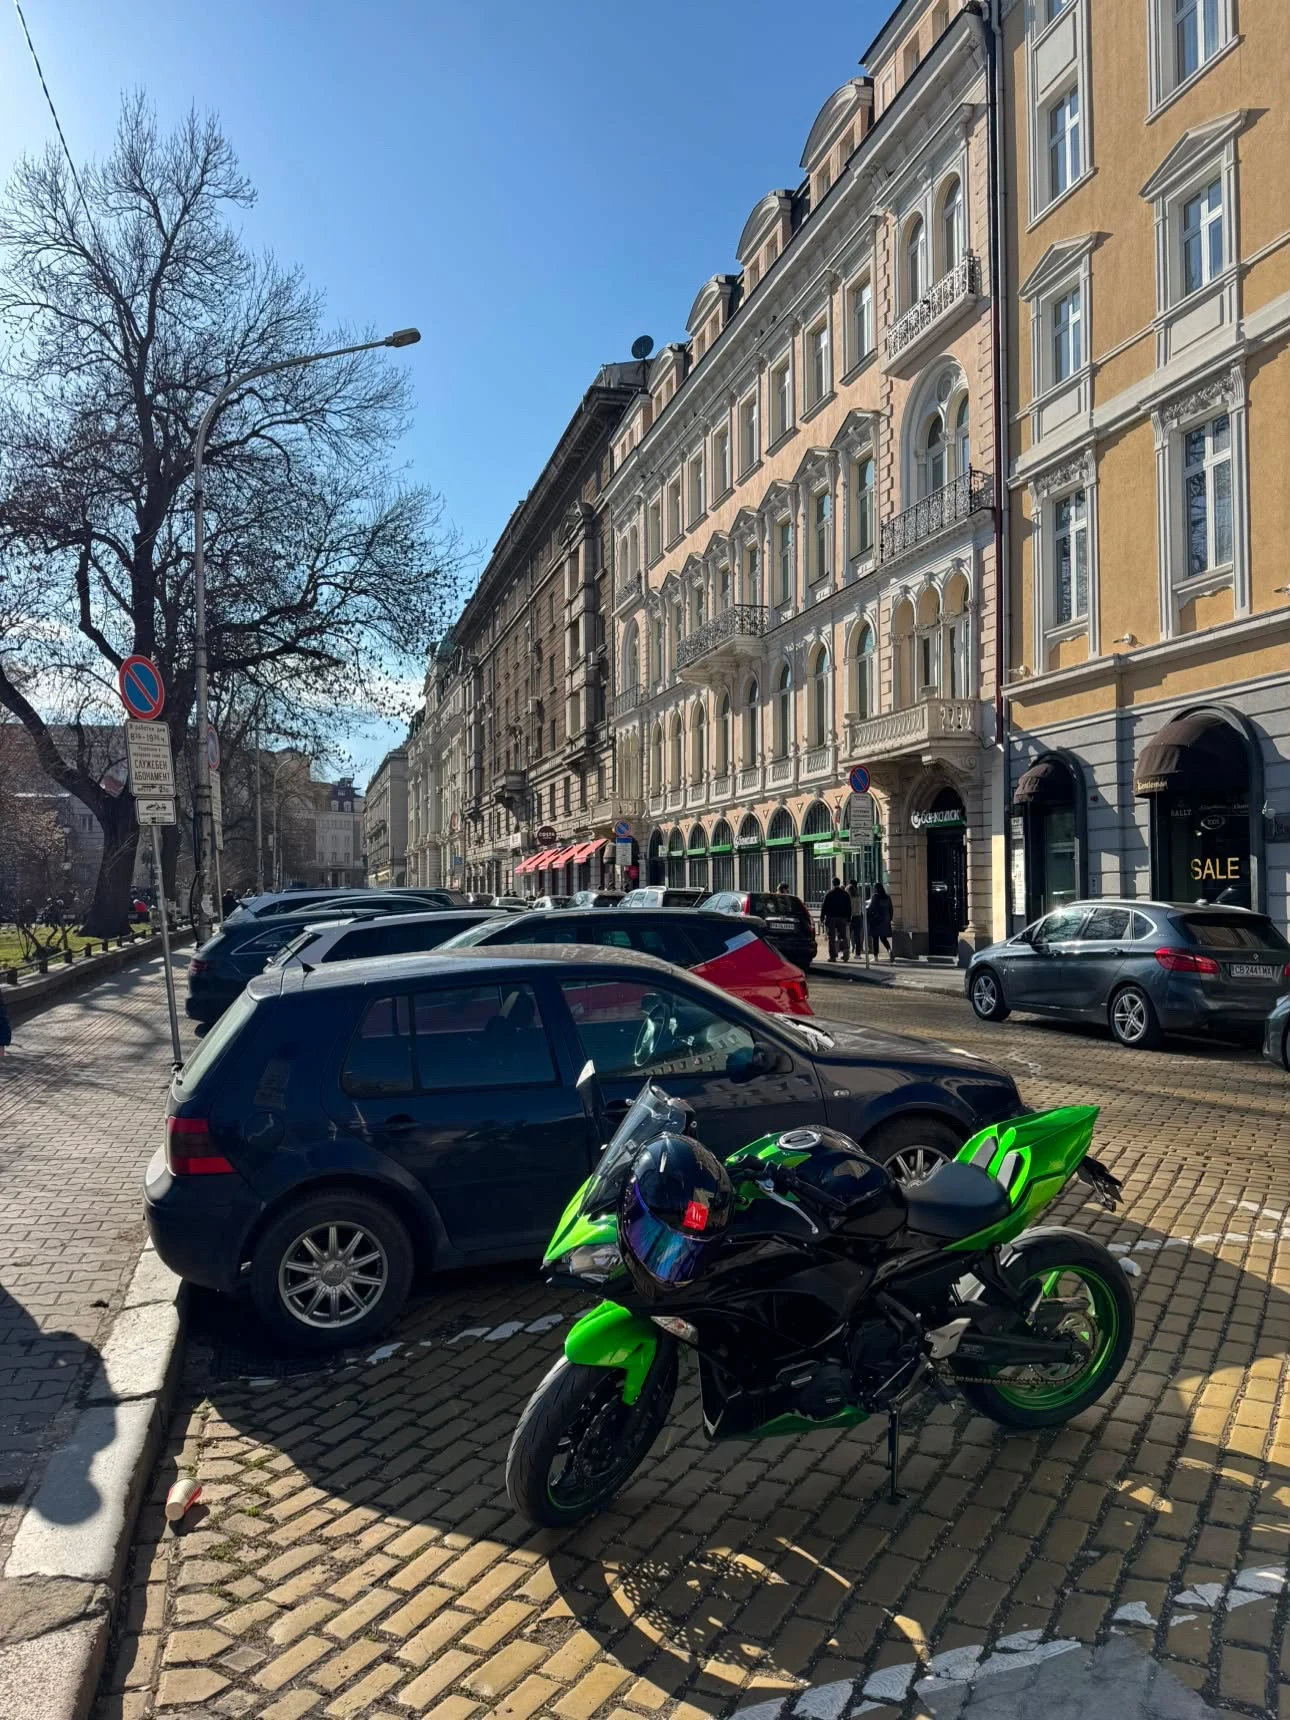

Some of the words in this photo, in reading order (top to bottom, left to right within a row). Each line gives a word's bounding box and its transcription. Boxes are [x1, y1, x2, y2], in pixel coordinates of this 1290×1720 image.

[134, 759, 168, 770] СЛУЖЕБЕН
[134, 771, 170, 781] АБОНАМЕНТ
[1190, 857, 1240, 881] SALE
